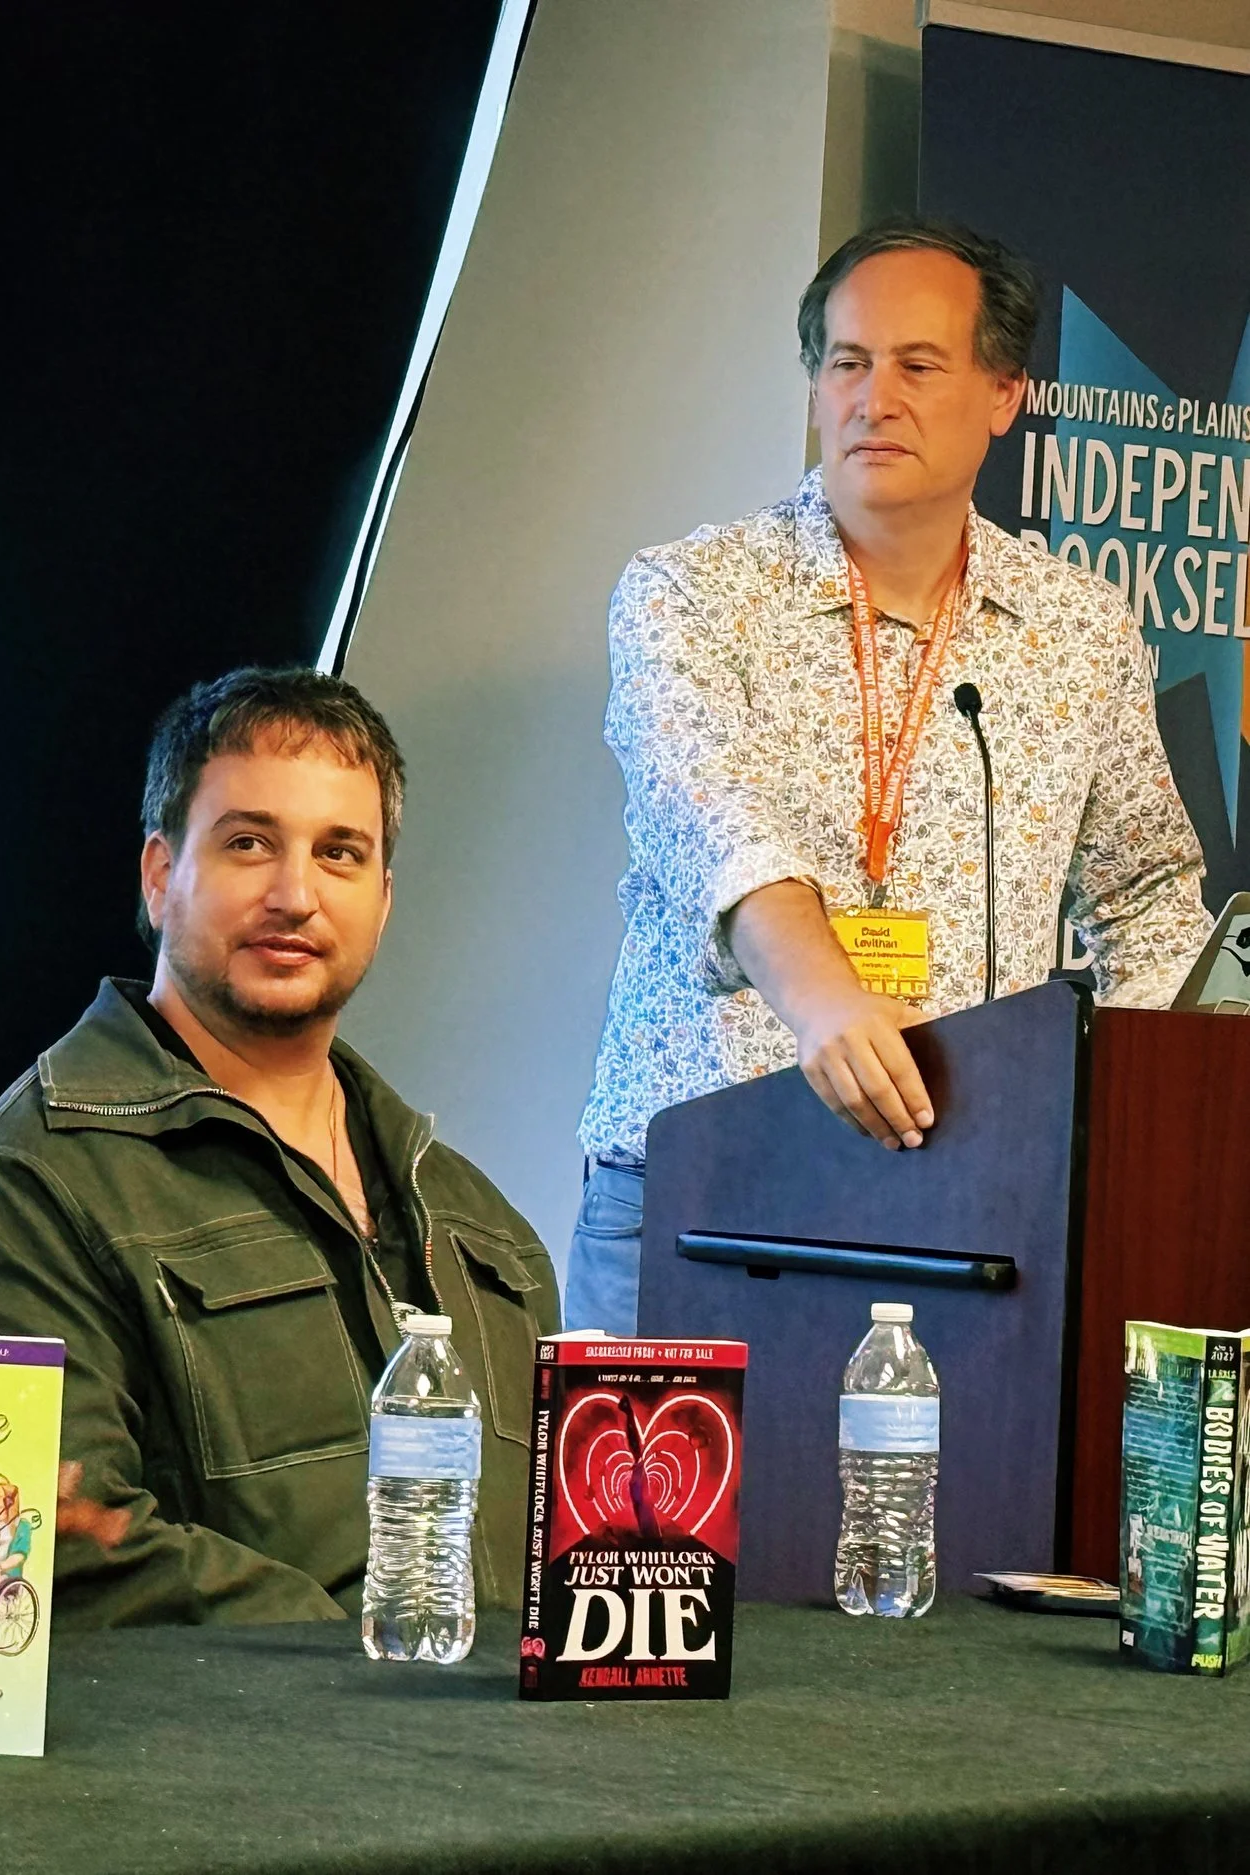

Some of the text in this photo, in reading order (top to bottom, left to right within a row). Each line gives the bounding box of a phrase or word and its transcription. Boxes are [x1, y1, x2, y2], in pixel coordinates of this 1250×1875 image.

[1026, 379, 1250, 442] MOUNTAINS & PLAINS
[1021, 431, 1250, 543] INDEPEN
[1020, 529, 1250, 639] OKSEL
[1200, 1405, 1234, 1496] BODIES
[1199, 1499, 1228, 1532] OF
[564, 1566, 714, 1586] JUST WON'T
[1193, 1533, 1230, 1620] WATER
[555, 1588, 716, 1662] DIE
